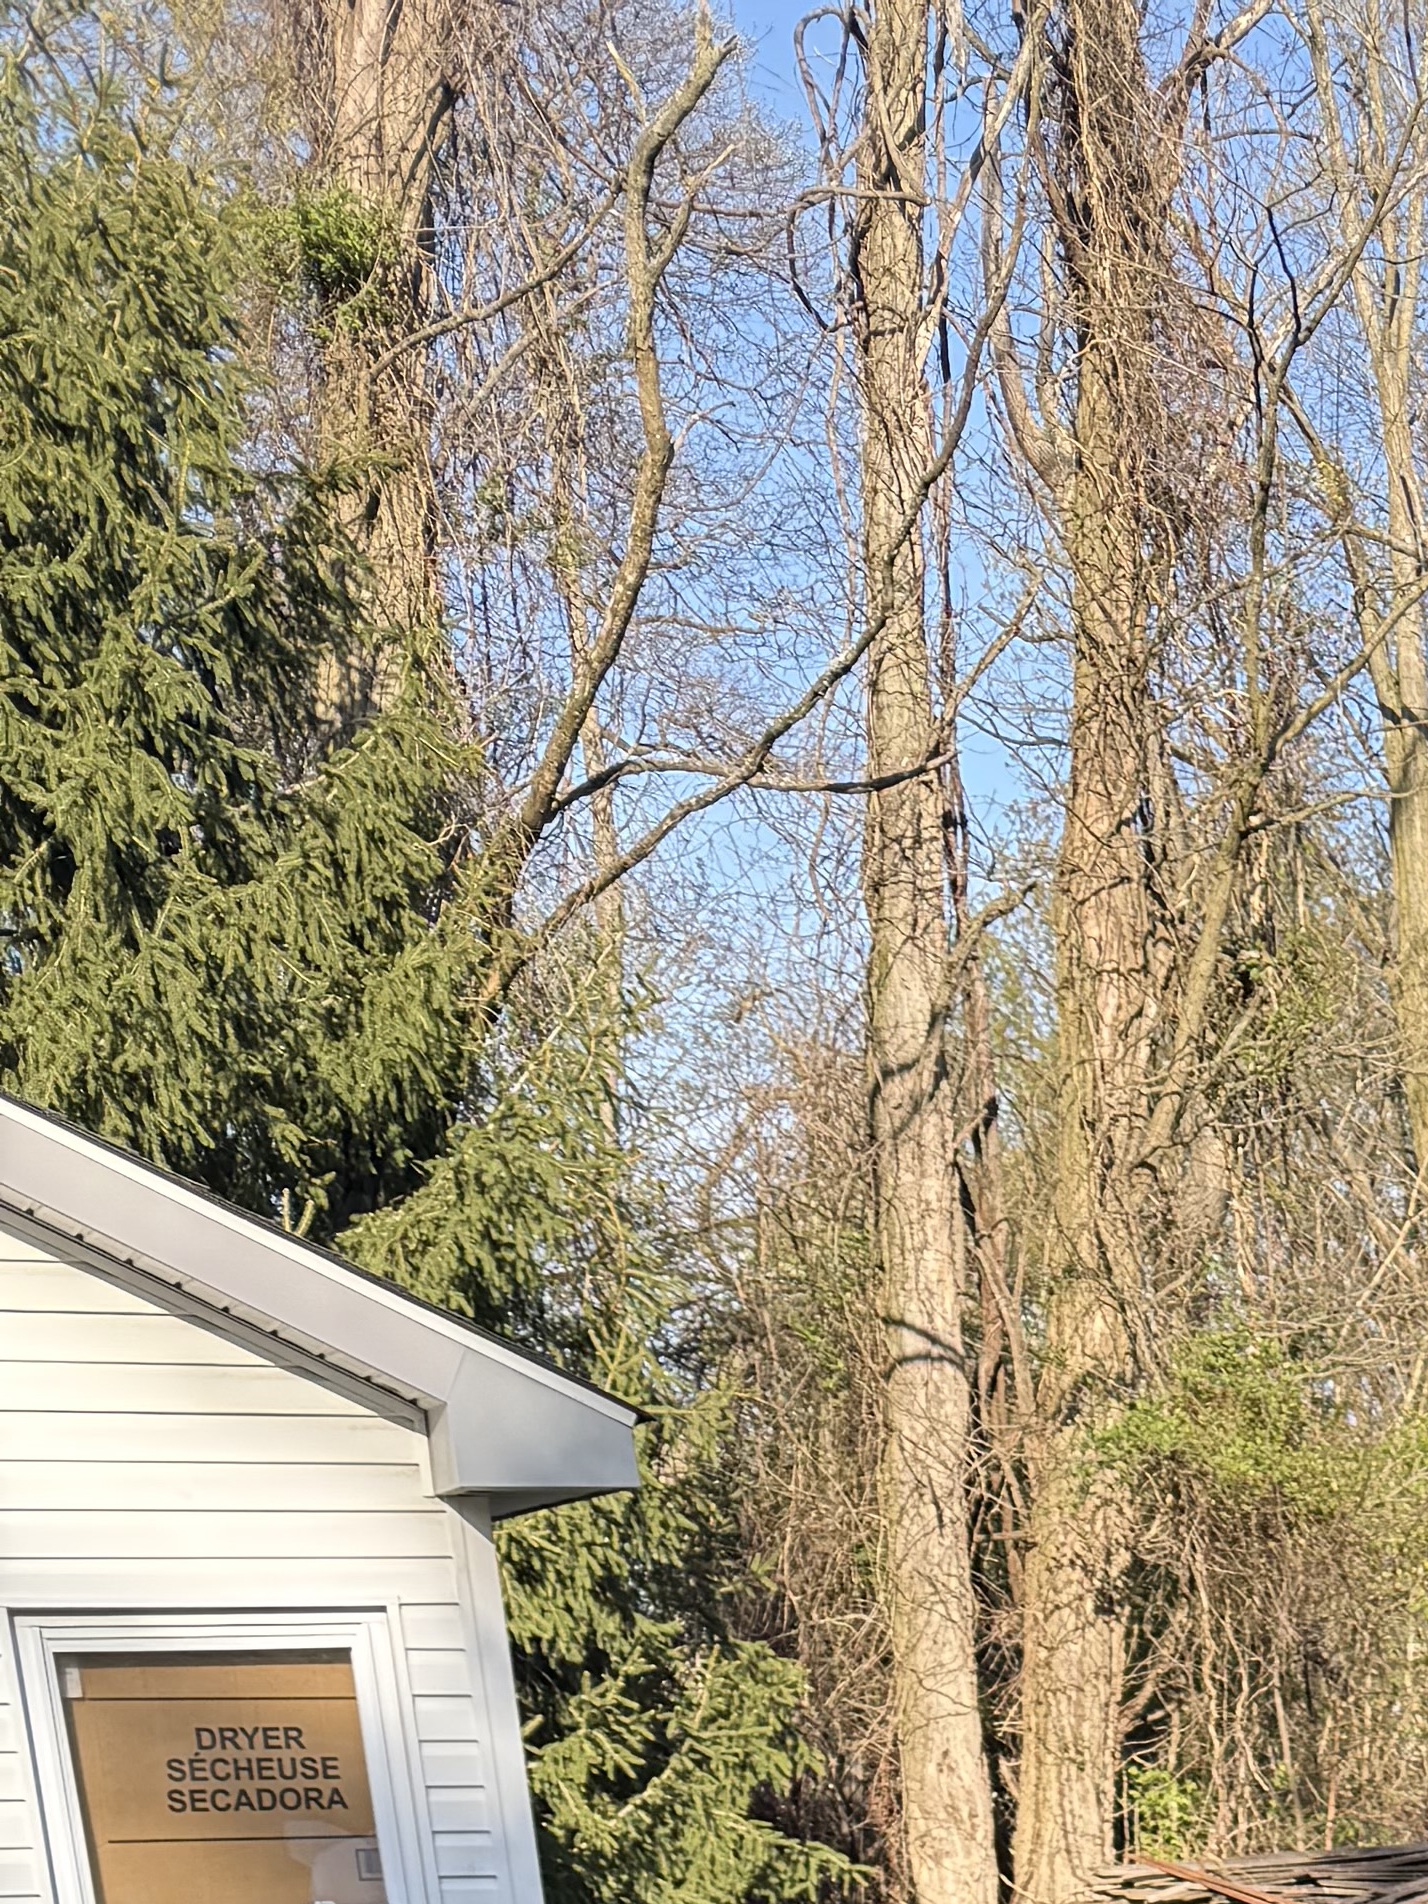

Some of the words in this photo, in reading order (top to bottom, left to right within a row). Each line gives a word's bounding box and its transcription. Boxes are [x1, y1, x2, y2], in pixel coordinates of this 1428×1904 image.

[194, 1726, 306, 1750] DRYER
[166, 1752, 341, 1782] SÉCHEUSE
[167, 1787, 349, 1813] SECADORA
